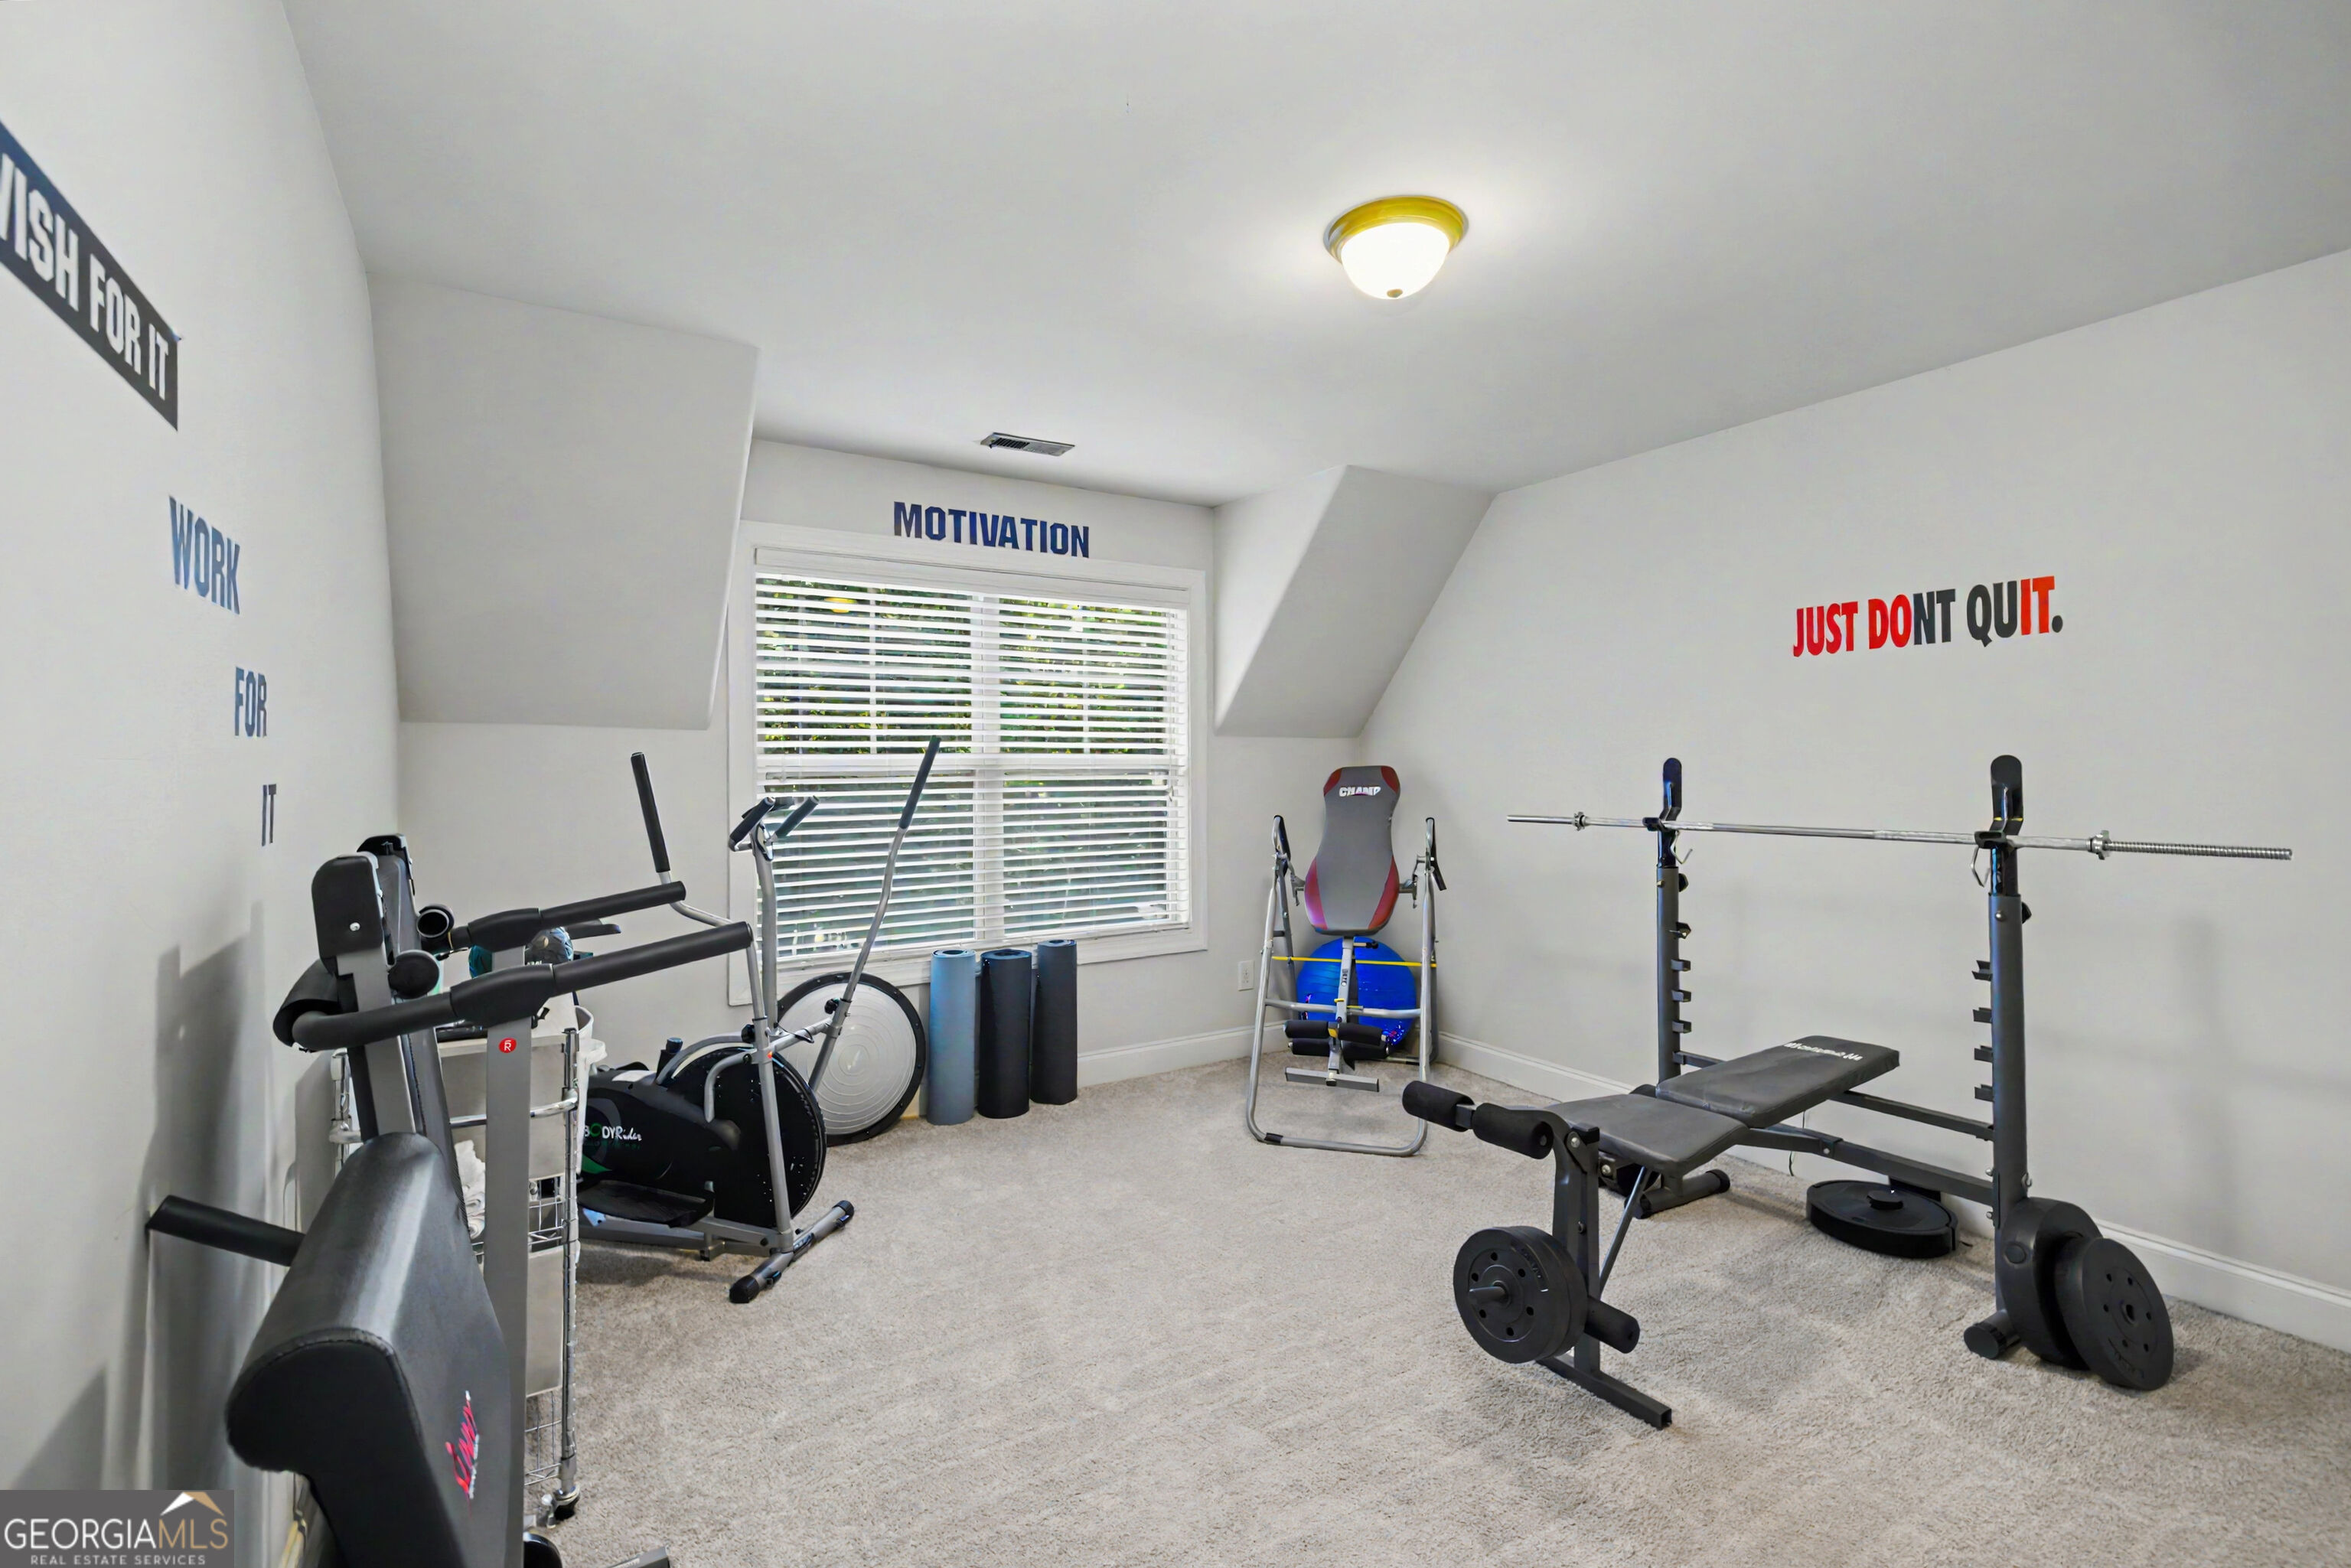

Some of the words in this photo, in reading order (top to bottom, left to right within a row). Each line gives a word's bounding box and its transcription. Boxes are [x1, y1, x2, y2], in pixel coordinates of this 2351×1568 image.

[90, 253, 141, 375] FOR
[148, 324, 168, 401] IT
[168, 496, 240, 615] WORK
[894, 501, 1089, 558] MOTIVATION
[1793, 601, 1858, 657] JUST
[1868, 588, 1956, 650] DONT
[1966, 575, 2063, 647] QUIT.
[234, 666, 267, 737] FOR
[261, 784, 277, 847] IT
[1339, 786, 1381, 797] CHAMP
